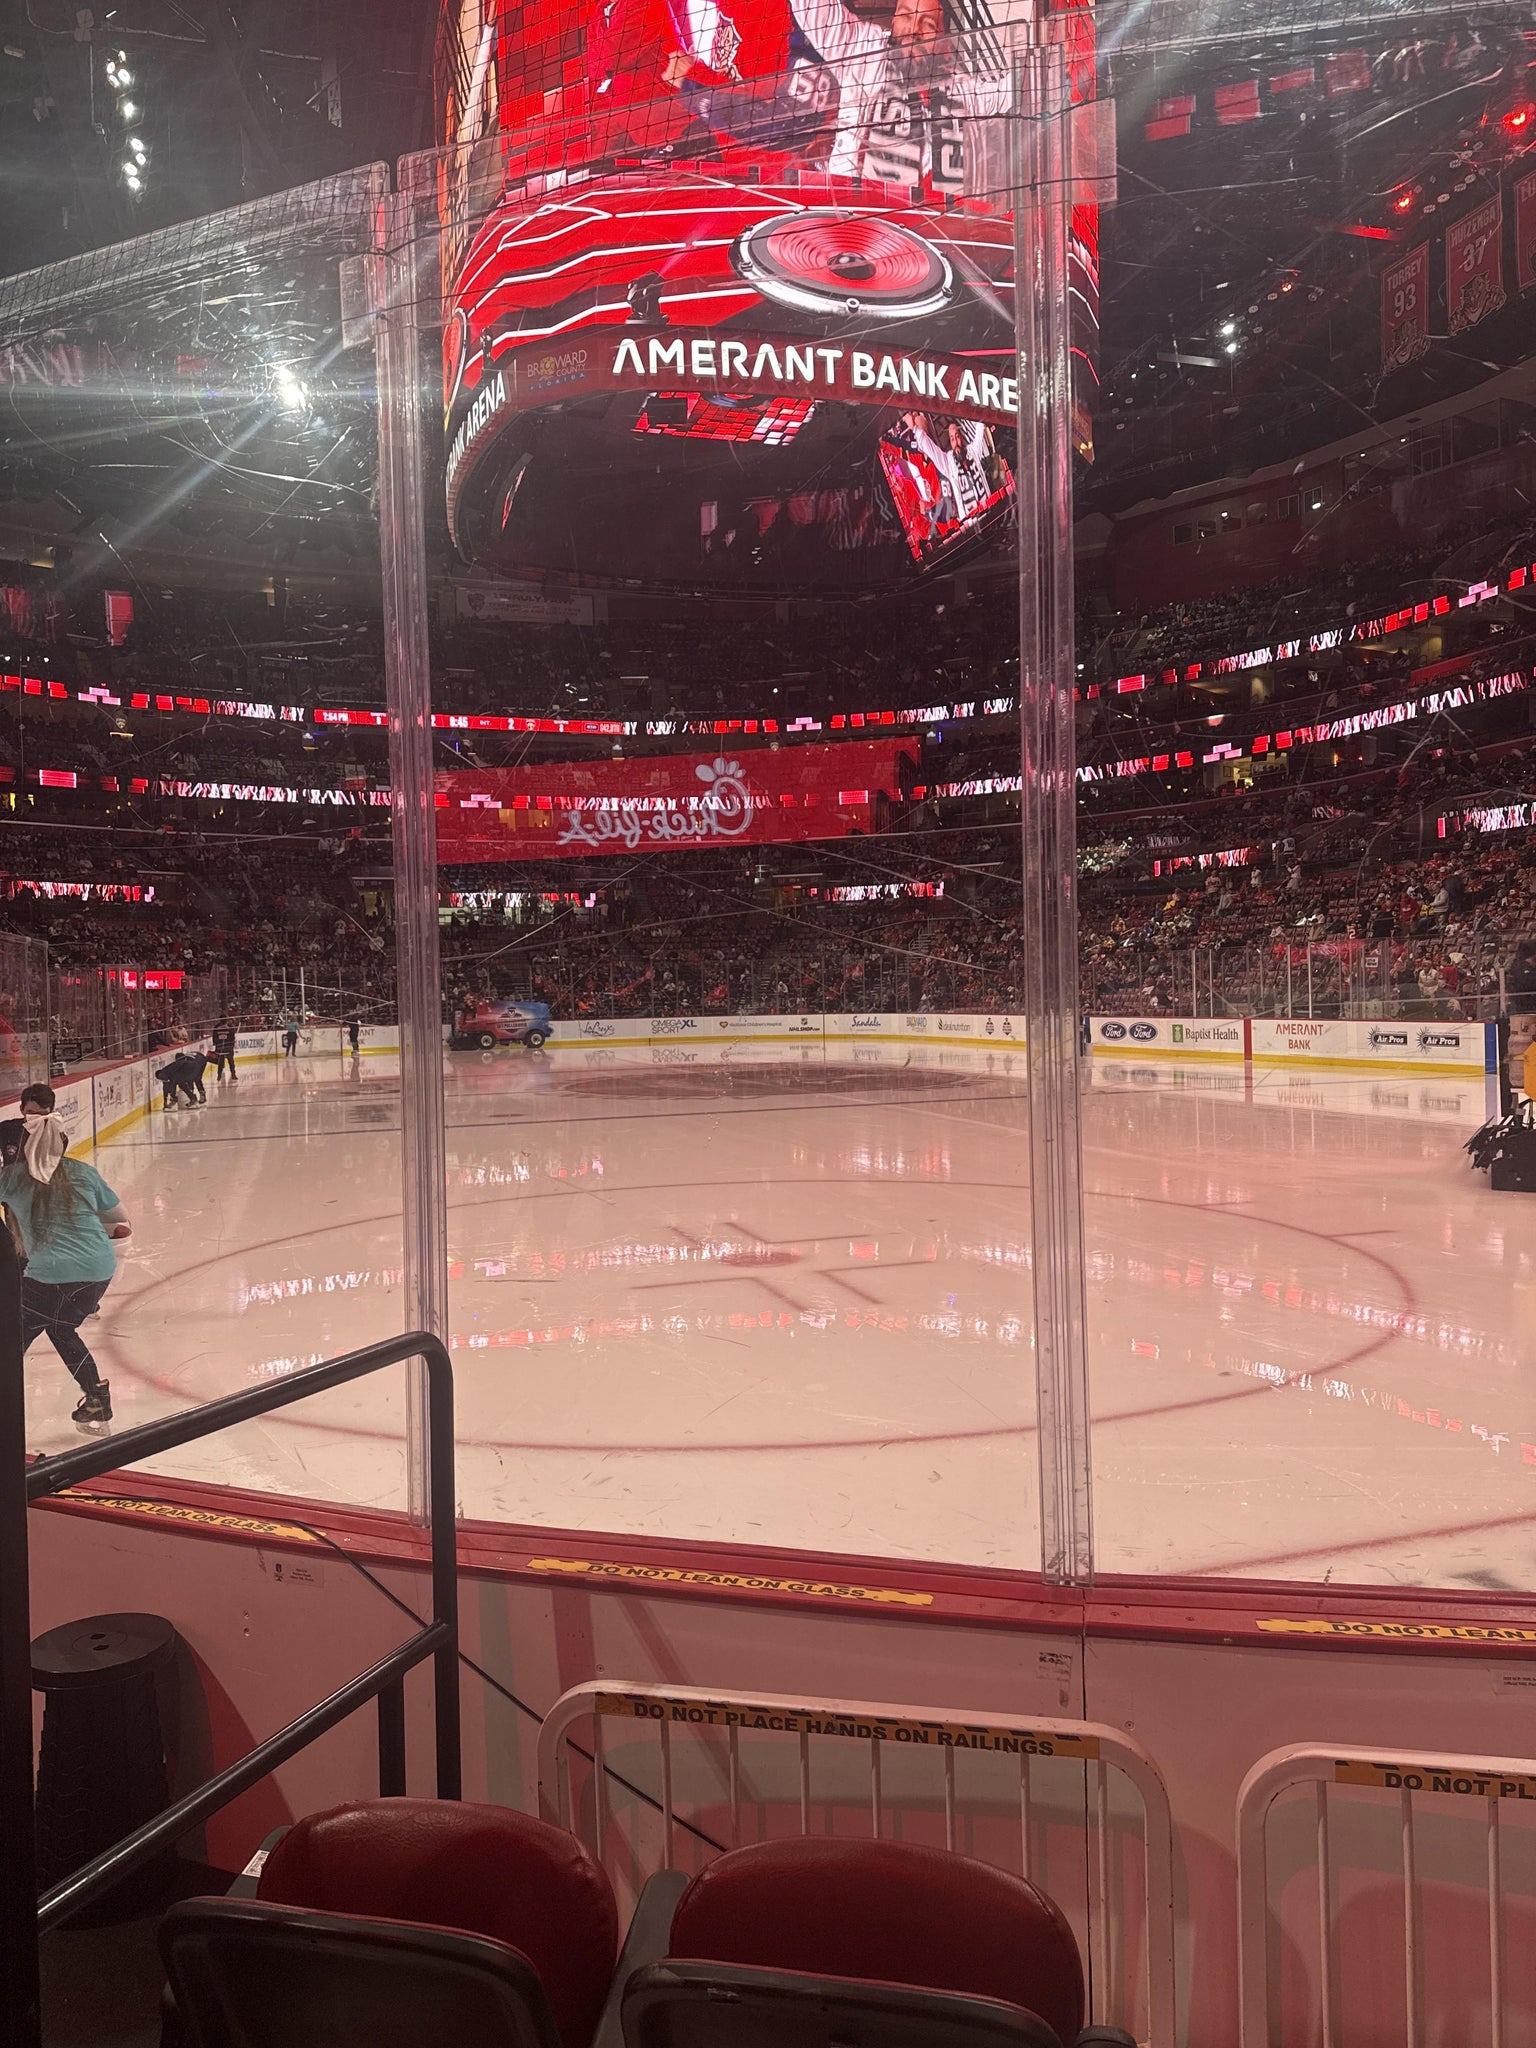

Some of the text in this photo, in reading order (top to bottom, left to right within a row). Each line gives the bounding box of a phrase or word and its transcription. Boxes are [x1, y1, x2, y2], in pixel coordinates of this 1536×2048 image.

[1451, 205, 1497, 247] HUIZENGA
[1463, 234, 1487, 273] 37
[1387, 256, 1423, 292] TORREY
[1394, 283, 1417, 318] 93
[556, 364, 586, 378] COUNTY
[612, 338, 843, 385] AMERANT
[853, 351, 950, 400] BANK
[466, 371, 506, 447] ARENA
[508, 718, 515, 730] 2
[681, 1019, 697, 1028] XL
[852, 1016, 881, 1028] Sandals
[1276, 1023, 1324, 1036] AMERANT
[1105, 1024, 1122, 1037] Ford
[1133, 1025, 1152, 1039] Ford
[1185, 1028, 1239, 1042] Baptist Health
[1288, 1039, 1311, 1050] BANK
[1377, 1035, 1404, 1044] Air Pros
[1426, 1036, 1456, 1046] Air Pros
[110, 1499, 148, 1511] NOT
[149, 1504, 189, 1520] LEAN
[192, 1512, 218, 1524] ON
[220, 1516, 279, 1533] GLASS
[587, 1564, 865, 1597] DO NOT LEAN ON GLASS
[1331, 1623, 1525, 1639] DO NOT LEAN
[634, 1702, 1054, 1756] DO NOT PLACE HANDS ON RAILINGS
[1385, 1773, 1536, 1800] DO NOT PL
